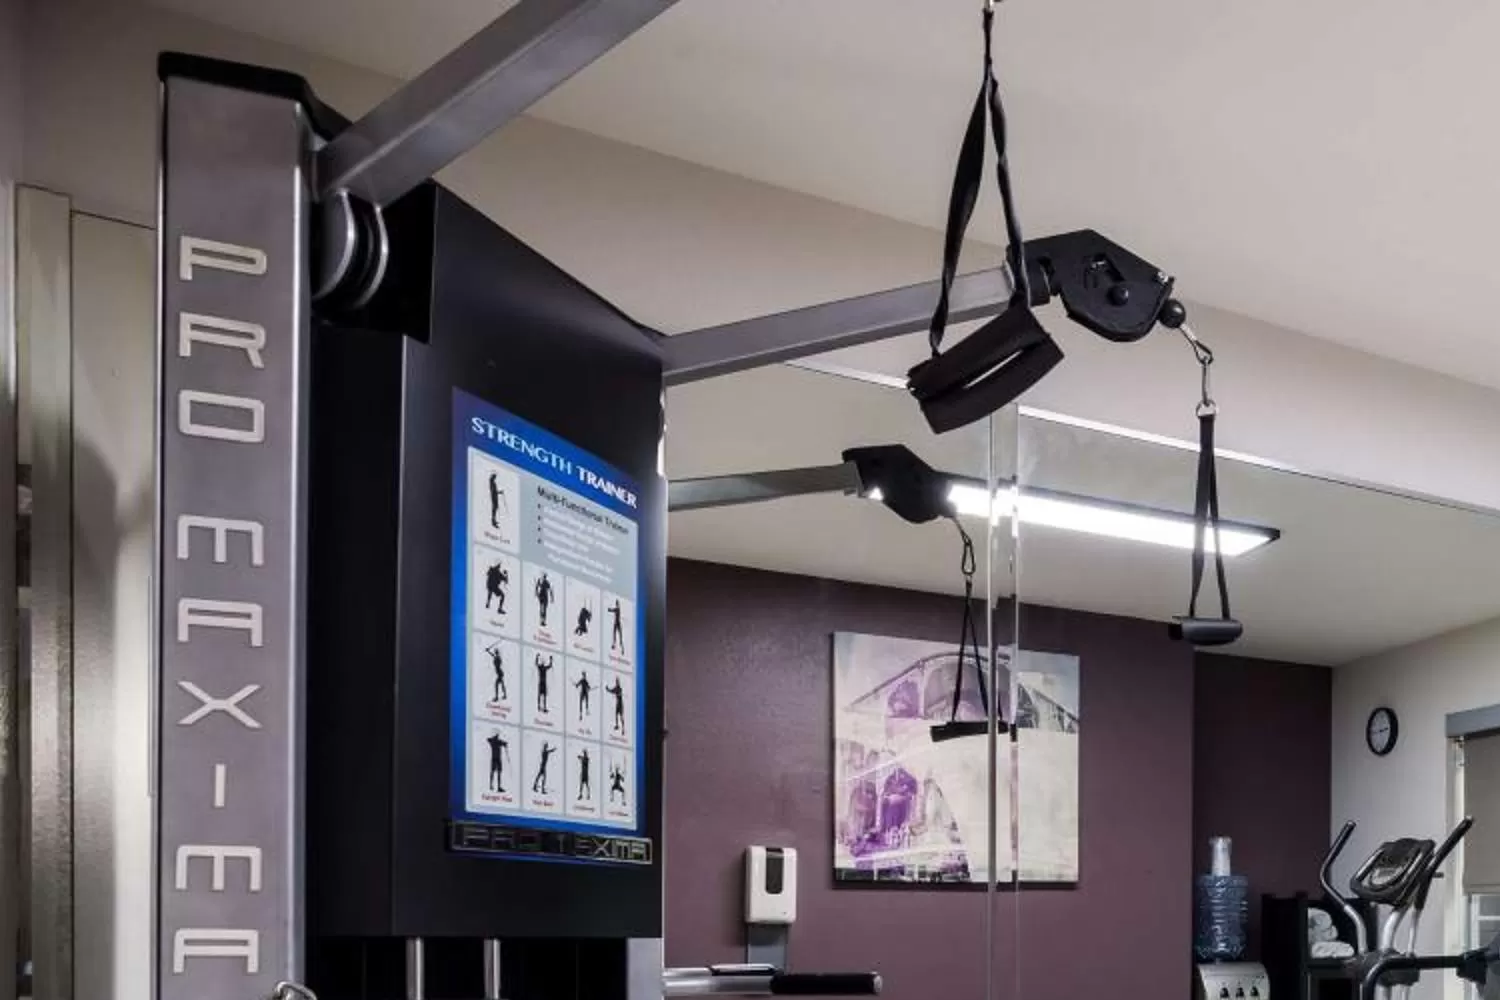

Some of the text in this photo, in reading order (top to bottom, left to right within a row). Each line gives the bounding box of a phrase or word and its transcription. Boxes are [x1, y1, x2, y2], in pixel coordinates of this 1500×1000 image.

[174, 235, 268, 974] PRO MAXIMA
[471, 416, 638, 510] STRENGTH TRAINER
